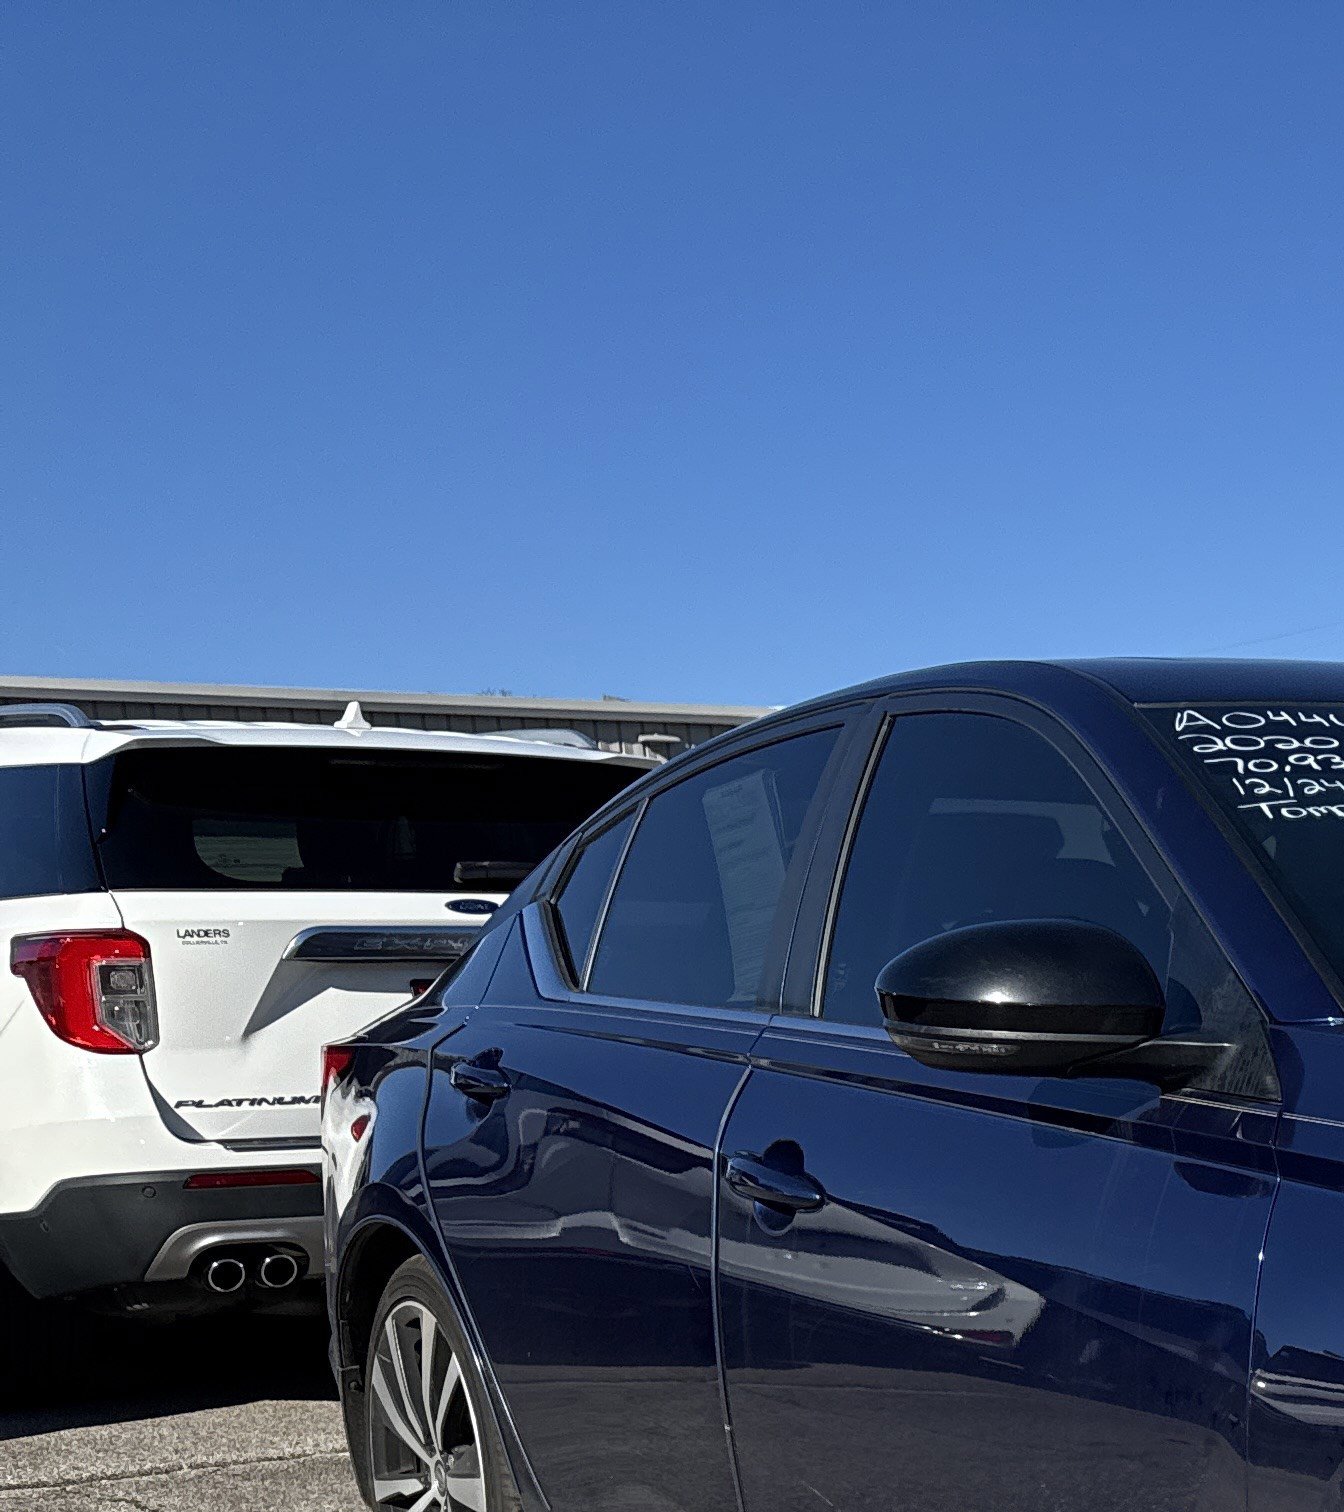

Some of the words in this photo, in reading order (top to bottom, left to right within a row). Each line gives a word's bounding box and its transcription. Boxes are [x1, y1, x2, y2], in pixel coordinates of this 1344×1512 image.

[1178, 733, 1340, 753] 2020
[176, 928, 231, 939] LANDERS
[174, 1094, 322, 1109] PLATINUM
